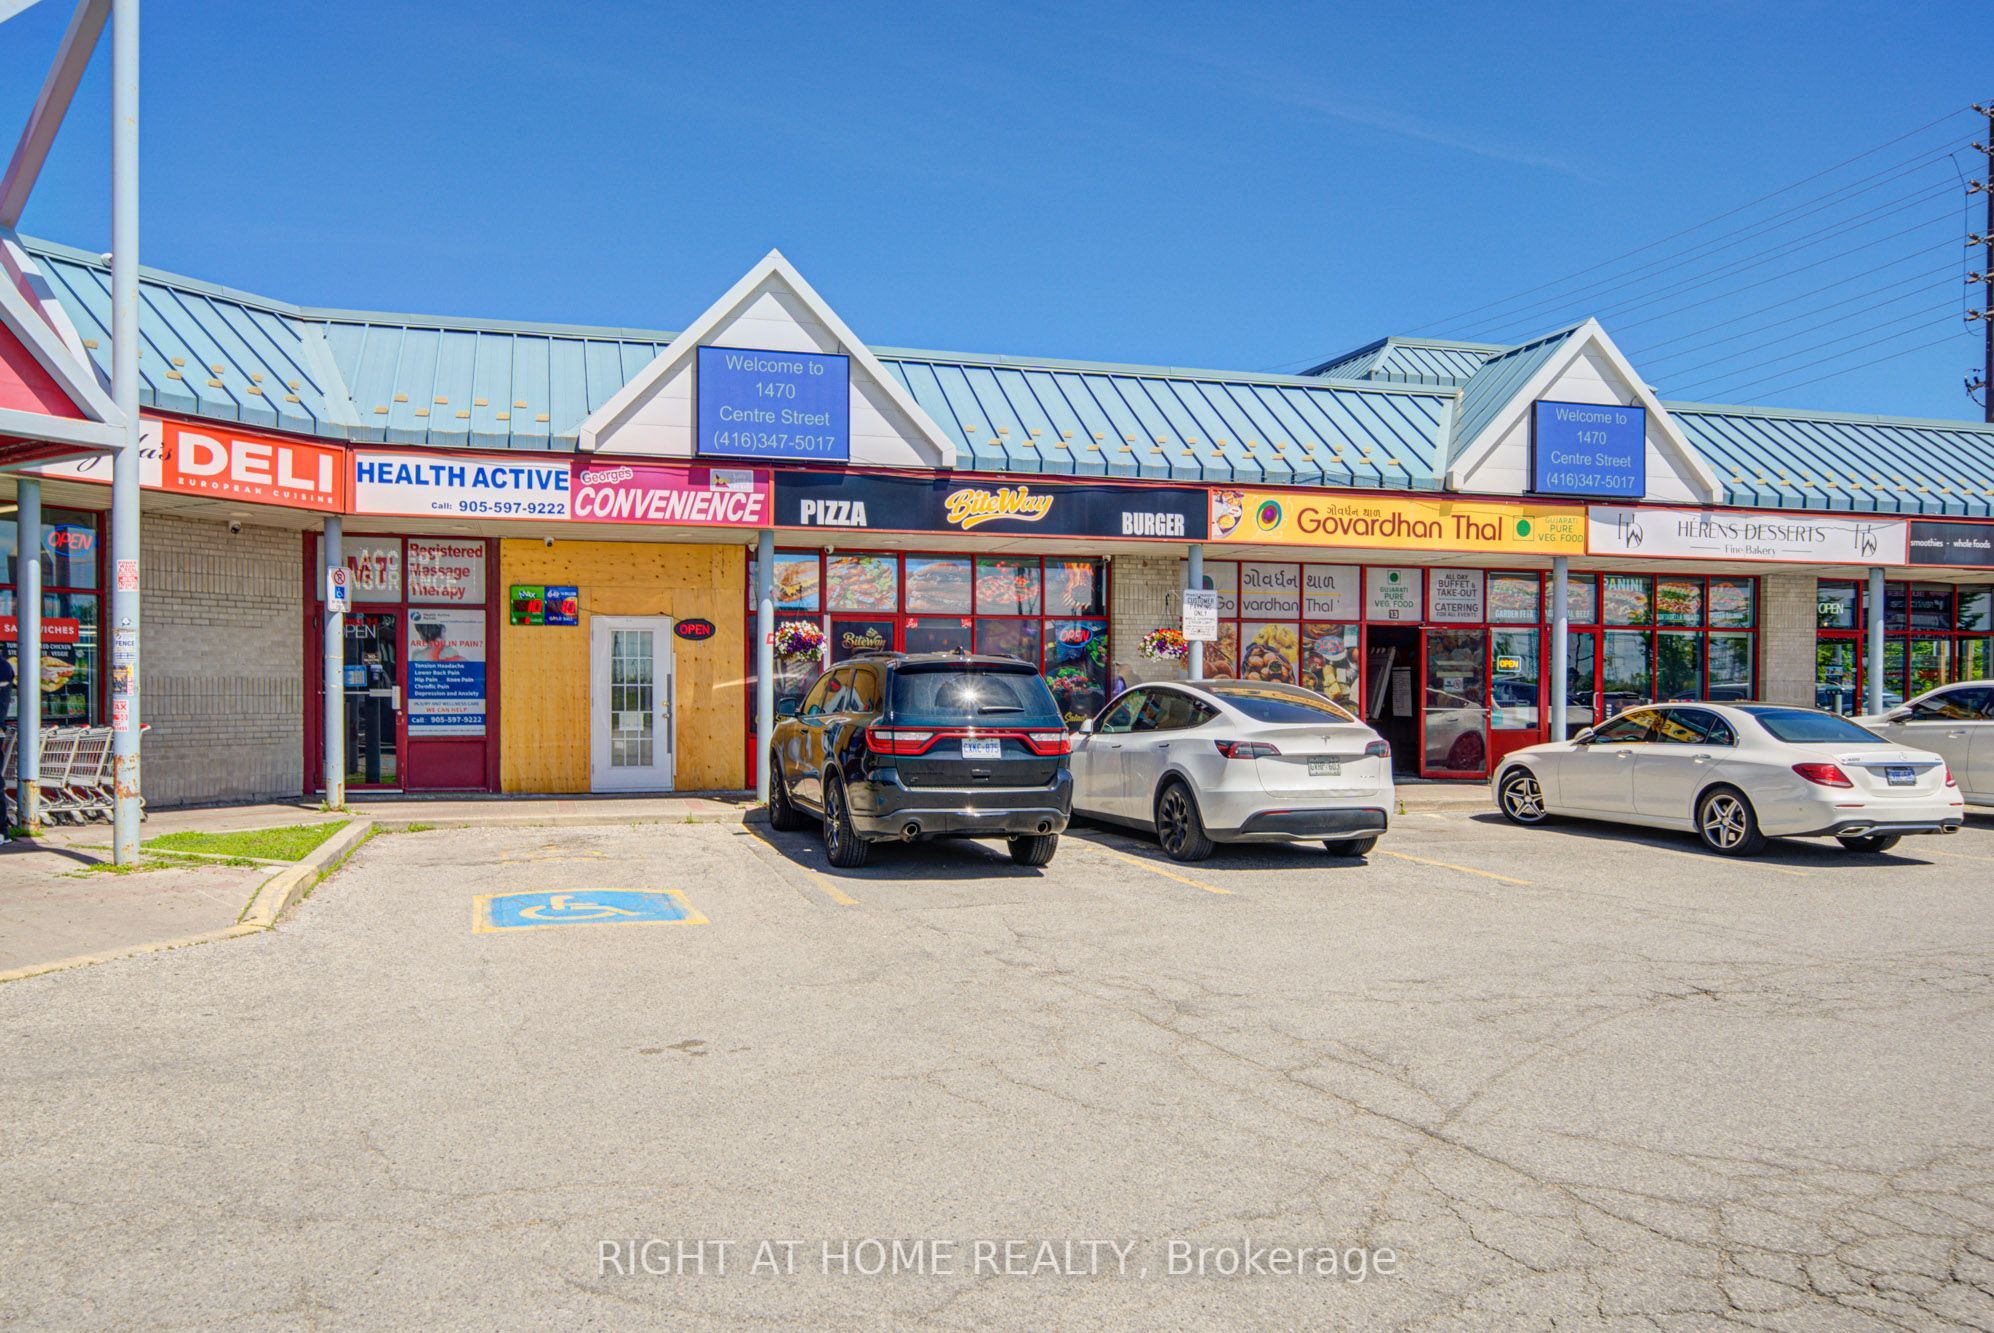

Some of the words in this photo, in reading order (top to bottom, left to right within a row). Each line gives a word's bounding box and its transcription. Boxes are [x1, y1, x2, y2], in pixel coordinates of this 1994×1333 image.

[726, 355, 803, 374] Welcome
[809, 361, 824, 375] to
[756, 382, 796, 399] 1470
[720, 406, 775, 423] Centre
[781, 409, 830, 426] Street
[1556, 408, 1612, 424] Welcome
[1616, 413, 1627, 424] to
[714, 431, 835, 451] (416)347-5017
[1577, 431, 1607, 445] 1470
[177, 431, 333, 493] DELI
[1551, 451, 1592, 465] Centre
[1596, 453, 1631, 467] Street
[357, 461, 465, 487] HEALTH
[472, 467, 569, 491] ACTIVE
[1547, 472, 1635, 488] (416)347-5017
[178, 477, 262, 495] EUROPEAN
[273, 489, 333, 504] CUISINE
[432, 502, 452, 510] Call:
[459, 500, 565, 515] 905-597-9222
[574, 487, 765, 522] CONVENIENCE
[800, 499, 867, 526] PIZZA
[1121, 511, 1185, 537] BURGER
[1297, 508, 1442, 538] Govardhan
[1452, 515, 1502, 541] Thal
[48, 530, 93, 550] OPEN
[1538, 534, 1555, 542] VEG
[1745, 523, 1826, 542] DESSERTS
[410, 543, 483, 560] Registered
[1725, 544, 1744, 554] Fine
[1746, 545, 1776, 558] Bakery
[1910, 538, 1943, 547] smoothies
[1953, 539, 1972, 548] whole
[1973, 539, 1991, 549] foods
[410, 563, 470, 580] Massage
[1438, 580, 1470, 588] BUFFET
[1602, 578, 1643, 592] PANINI
[1437, 589, 1477, 597] TAKE-OUT
[1305, 598, 1334, 612] Thal
[1435, 603, 1479, 612] CATERING
[1818, 603, 1844, 614] OPEN
[3, 624, 75, 635] SAICHES
[679, 624, 710, 635] OPEN
[1059, 628, 1090, 643] OPEN
[1499, 659, 1519, 668] OPEN
